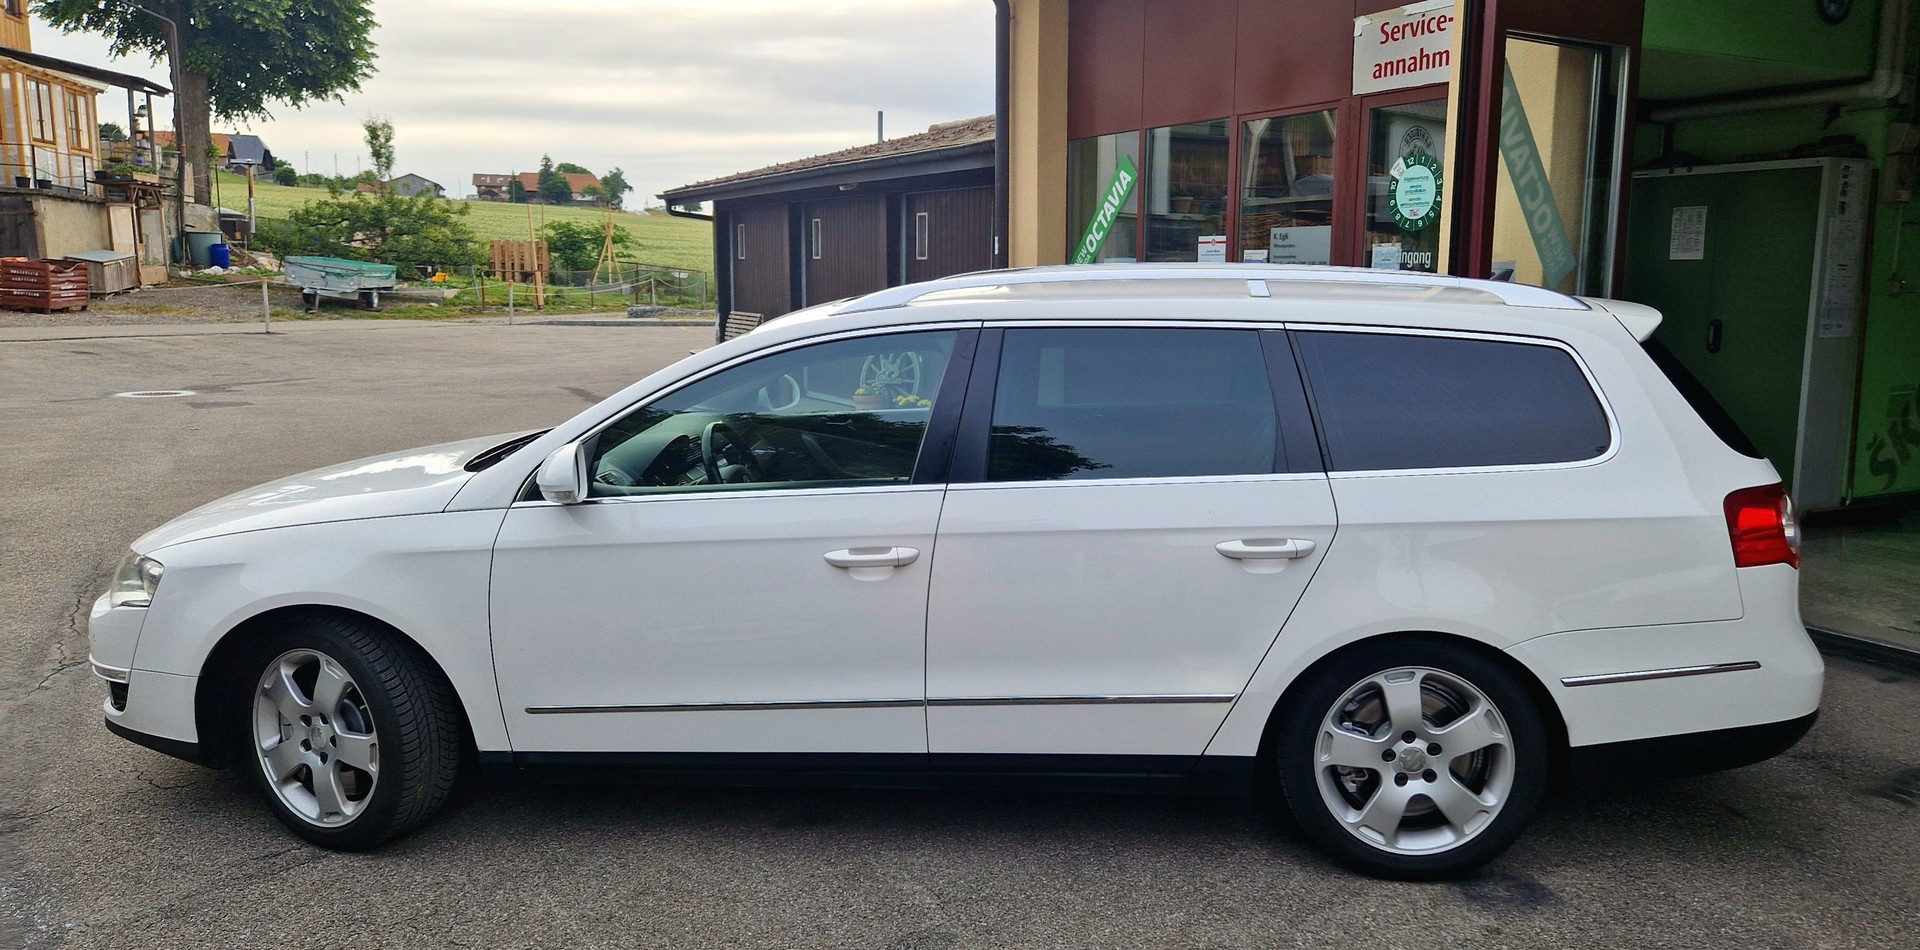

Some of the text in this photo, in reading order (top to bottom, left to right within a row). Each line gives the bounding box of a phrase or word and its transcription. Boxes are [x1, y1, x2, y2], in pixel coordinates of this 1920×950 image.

[1380, 14, 1454, 45] Service-
[1373, 48, 1450, 79] annahm
[1407, 157, 1415, 166] 12
[1421, 156, 1425, 164] 1
[1430, 163, 1437, 172] 2
[1390, 181, 1397, 190] 10
[1436, 178, 1442, 186] 3
[1085, 170, 1132, 253] OCTAVIA
[1395, 213, 1400, 221] 8
[1405, 220, 1410, 228] 7
[1417, 220, 1423, 228] 6
[1399, 249, 1432, 269] ingang
[1866, 385, 1920, 491] ŠK
